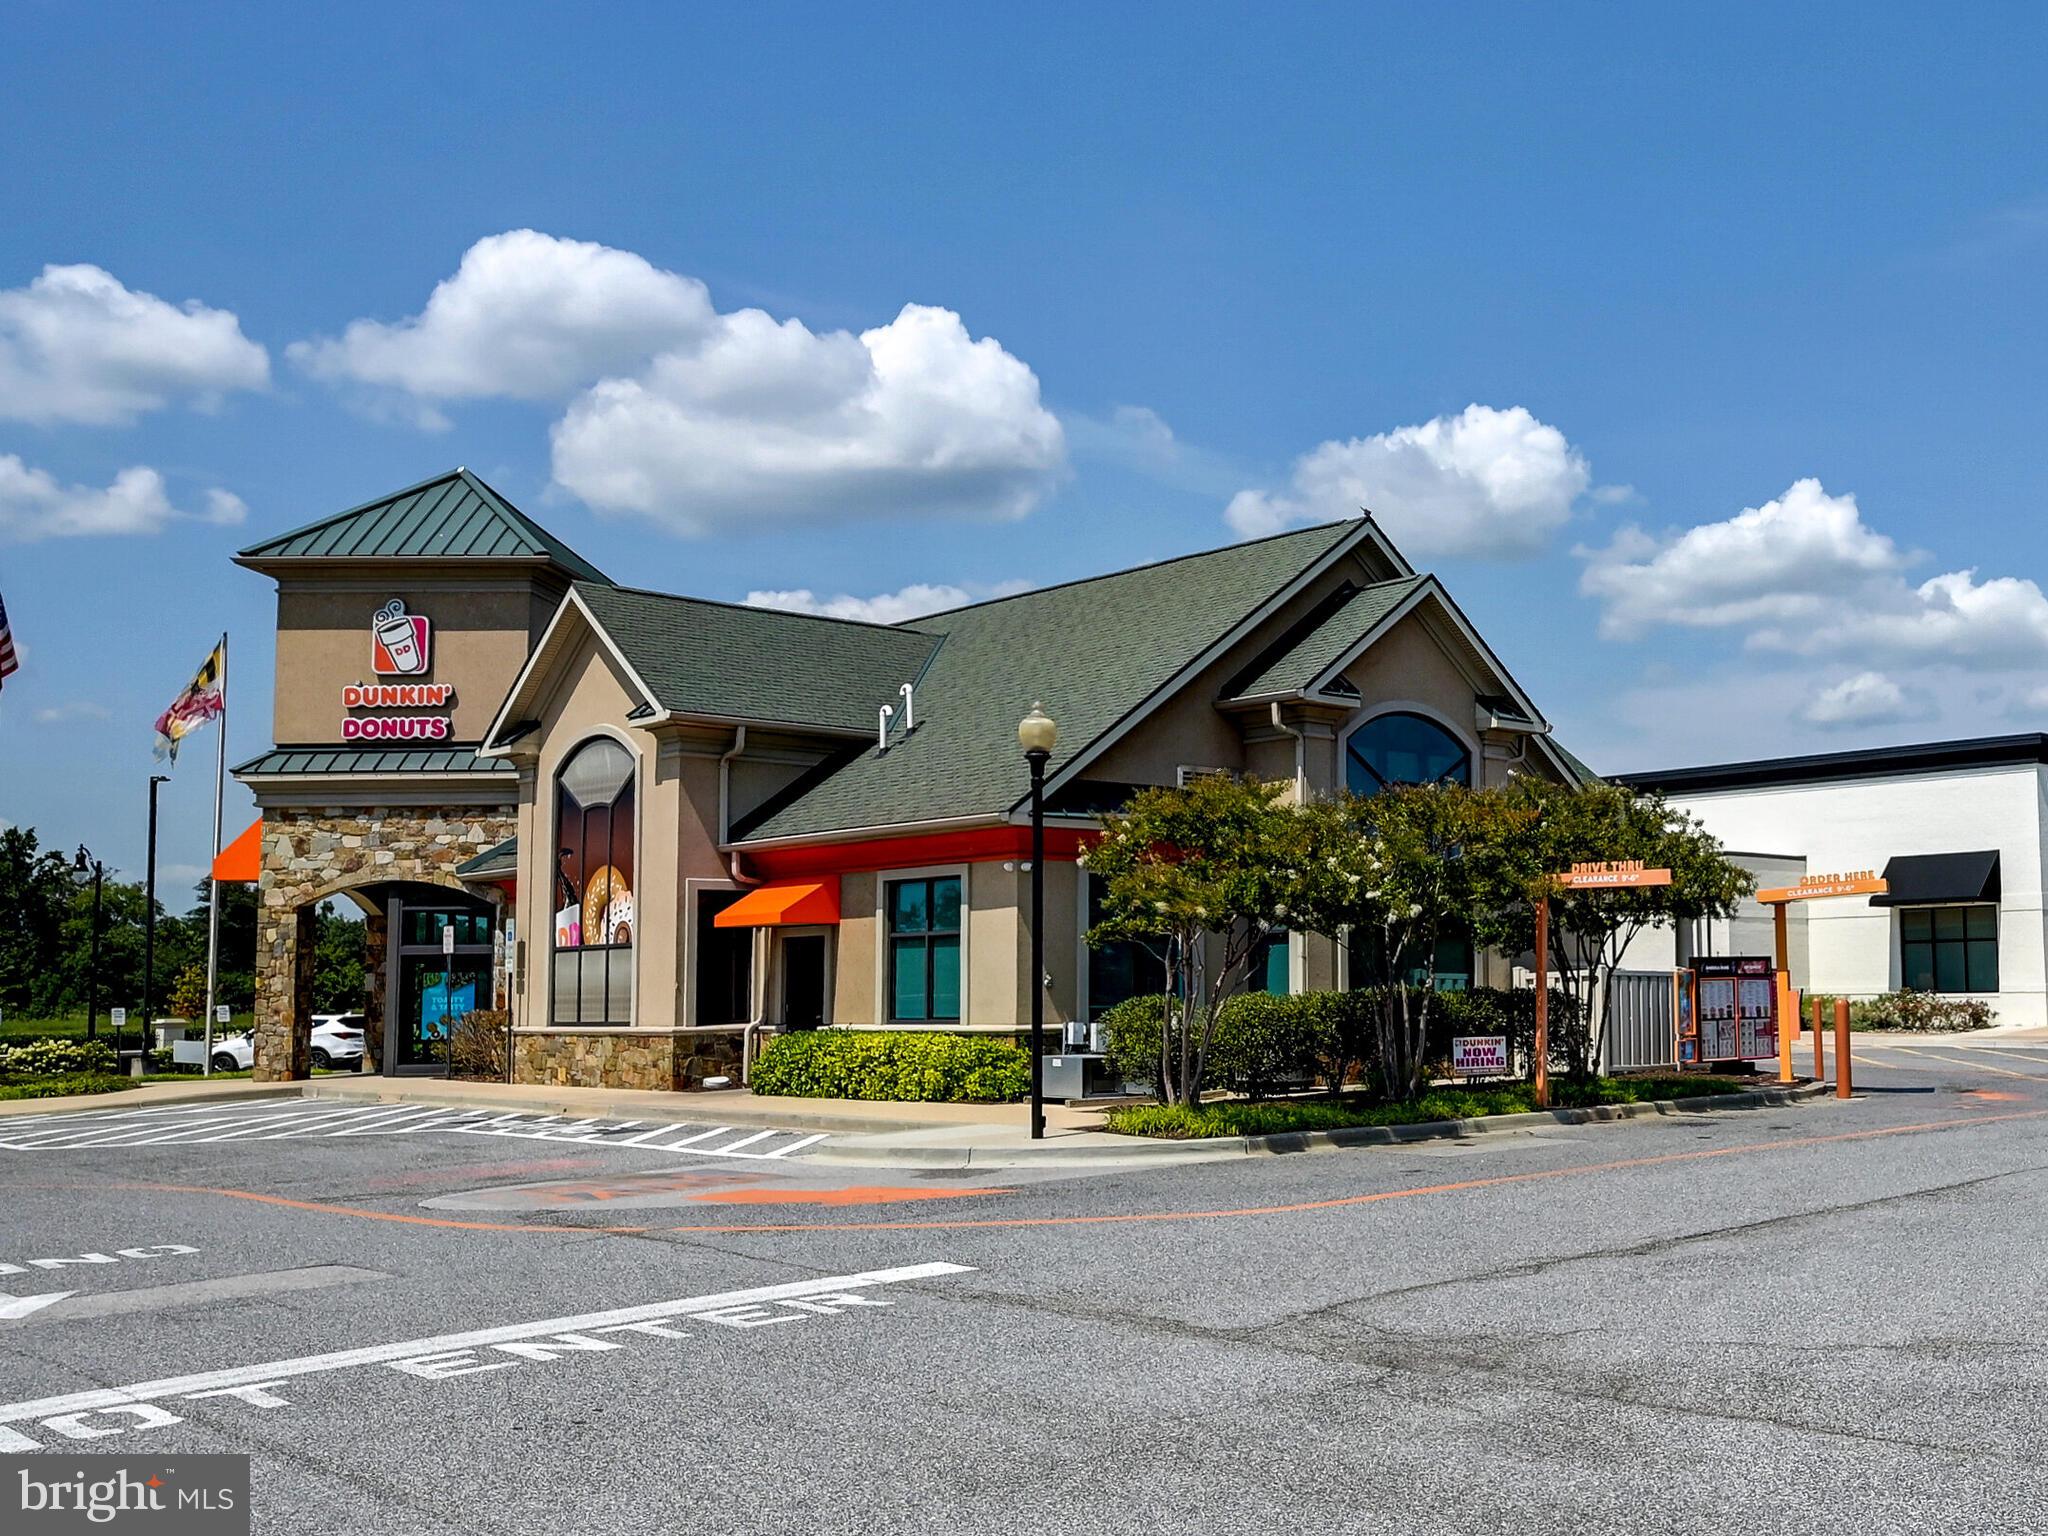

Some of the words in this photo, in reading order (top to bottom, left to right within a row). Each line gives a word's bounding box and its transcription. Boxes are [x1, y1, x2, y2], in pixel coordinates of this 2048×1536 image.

[395, 644, 411, 656] DD
[343, 685, 452, 707] DUNKIN'
[342, 718, 448, 739] DONUTS
[1571, 862, 1607, 874] DRIVE
[1611, 860, 1644, 871] THRU
[1573, 875, 1618, 884] CLEARANCE
[1800, 873, 1840, 886] ORDER
[1844, 870, 1875, 882] HERE
[1787, 886, 1833, 897] CLEARANCE
[1463, 1047, 1497, 1057] NOW
[1456, 1057, 1505, 1067] HIRING
[386, 1292, 894, 1379] ENTER
